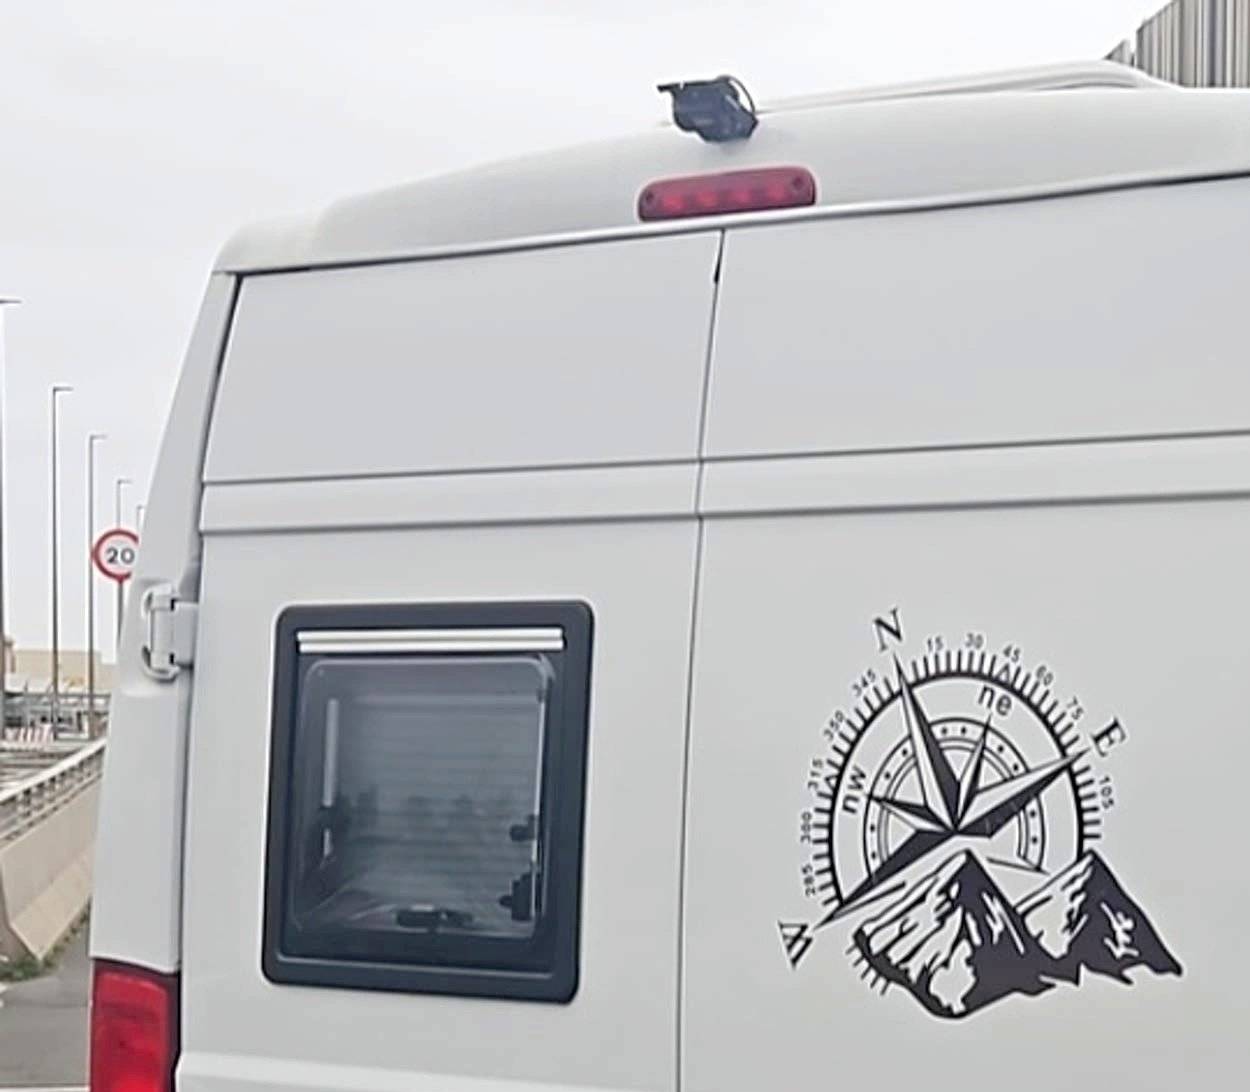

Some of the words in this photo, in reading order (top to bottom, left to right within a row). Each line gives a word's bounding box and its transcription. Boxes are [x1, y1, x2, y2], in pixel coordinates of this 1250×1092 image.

[106, 546, 135, 564] 20
[874, 608, 902, 651] N
[927, 636, 944, 651] 15
[965, 632, 984, 649] 30
[1003, 644, 1020, 663] 45
[852, 668, 876, 696] 345
[1035, 665, 1054, 686] 60
[978, 684, 1012, 716] ne
[1066, 696, 1084, 720] 75
[1091, 716, 1126, 757] E
[808, 759, 824, 789] 315
[1099, 776, 1114, 809] 105
[778, 920, 813, 968] W
